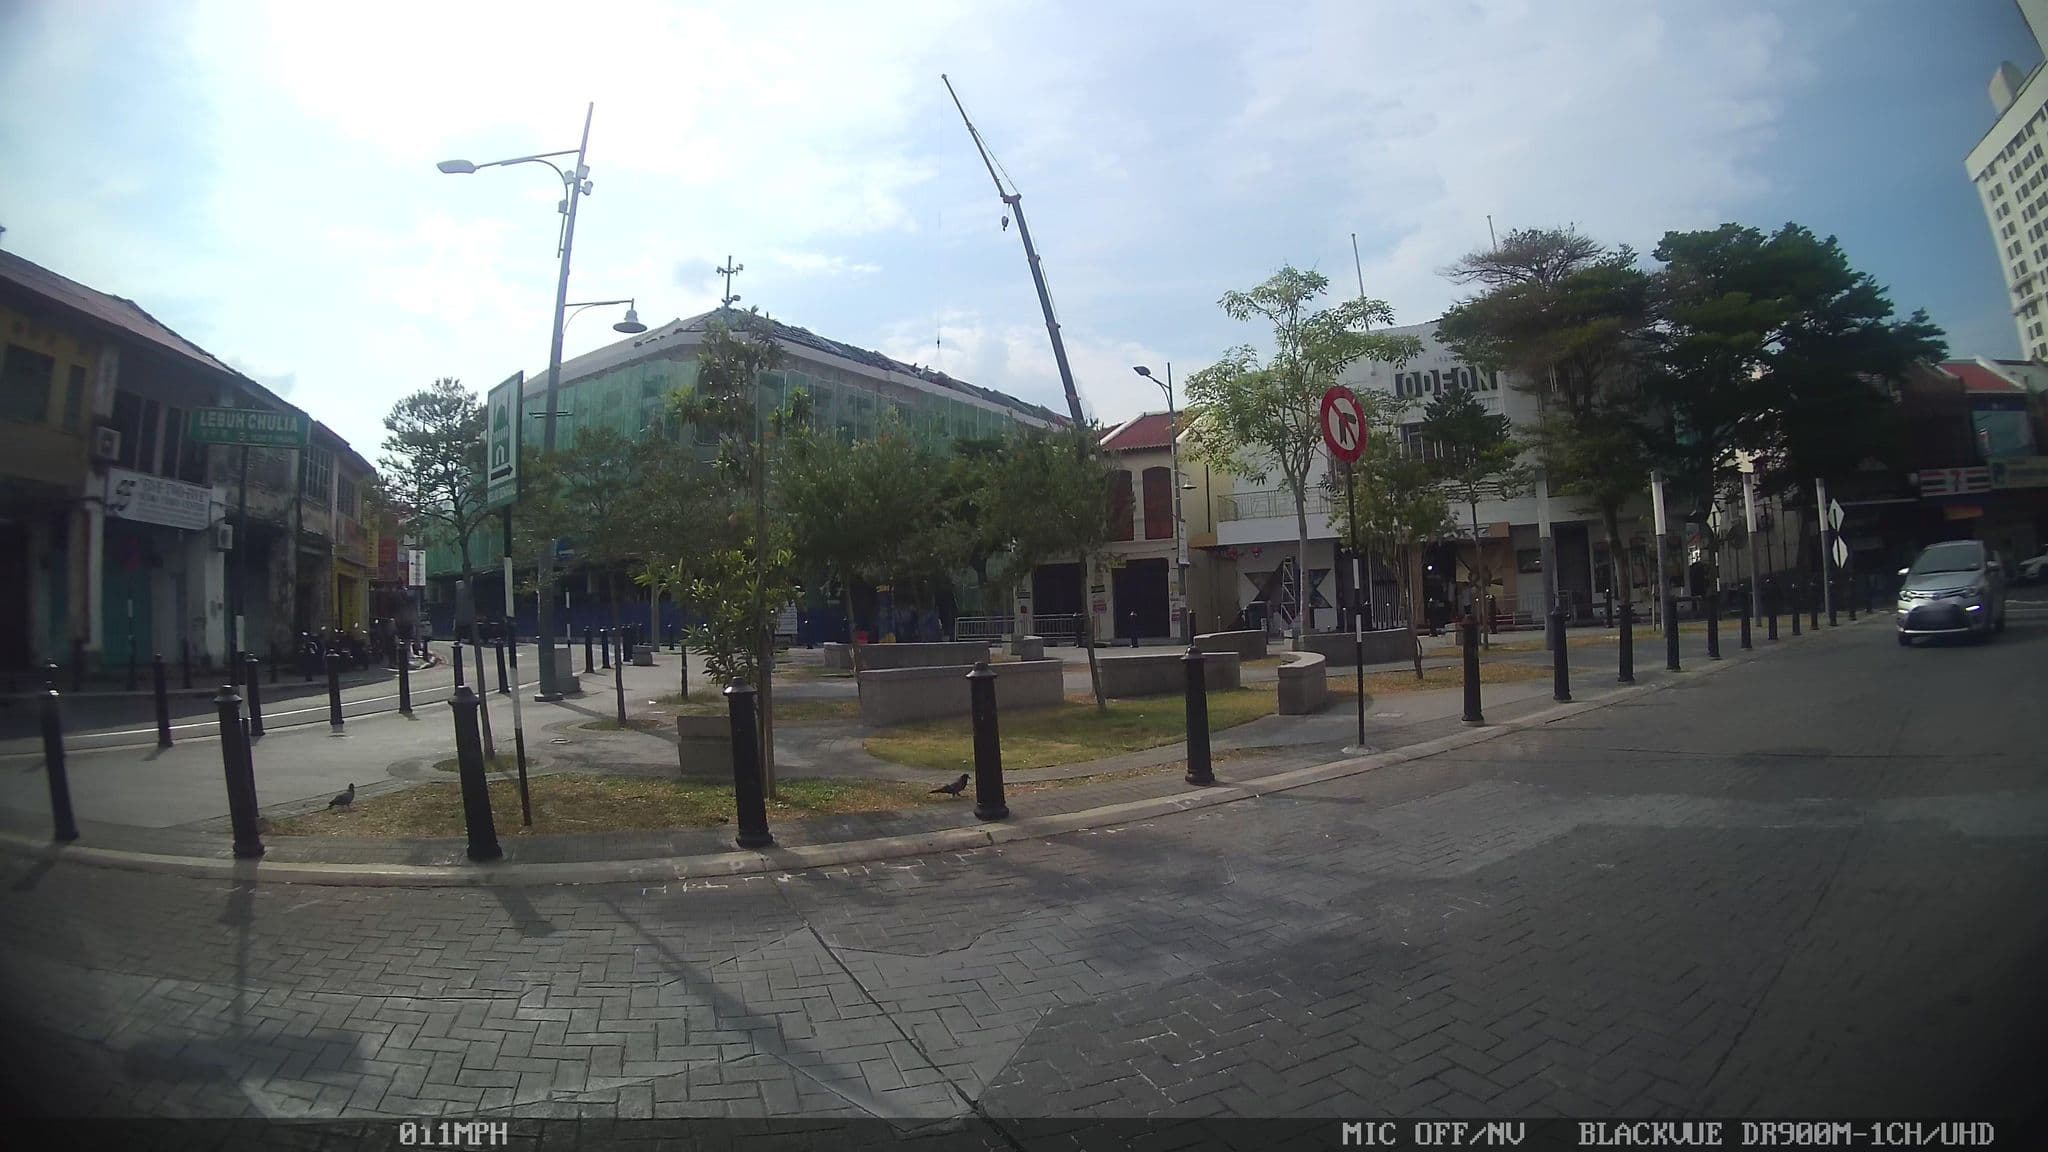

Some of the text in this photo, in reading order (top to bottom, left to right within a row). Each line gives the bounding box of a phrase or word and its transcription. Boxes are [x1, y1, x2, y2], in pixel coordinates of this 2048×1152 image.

[1395, 366, 1498, 399] ODEON
[200, 410, 298, 433] LEBUH CHULIA
